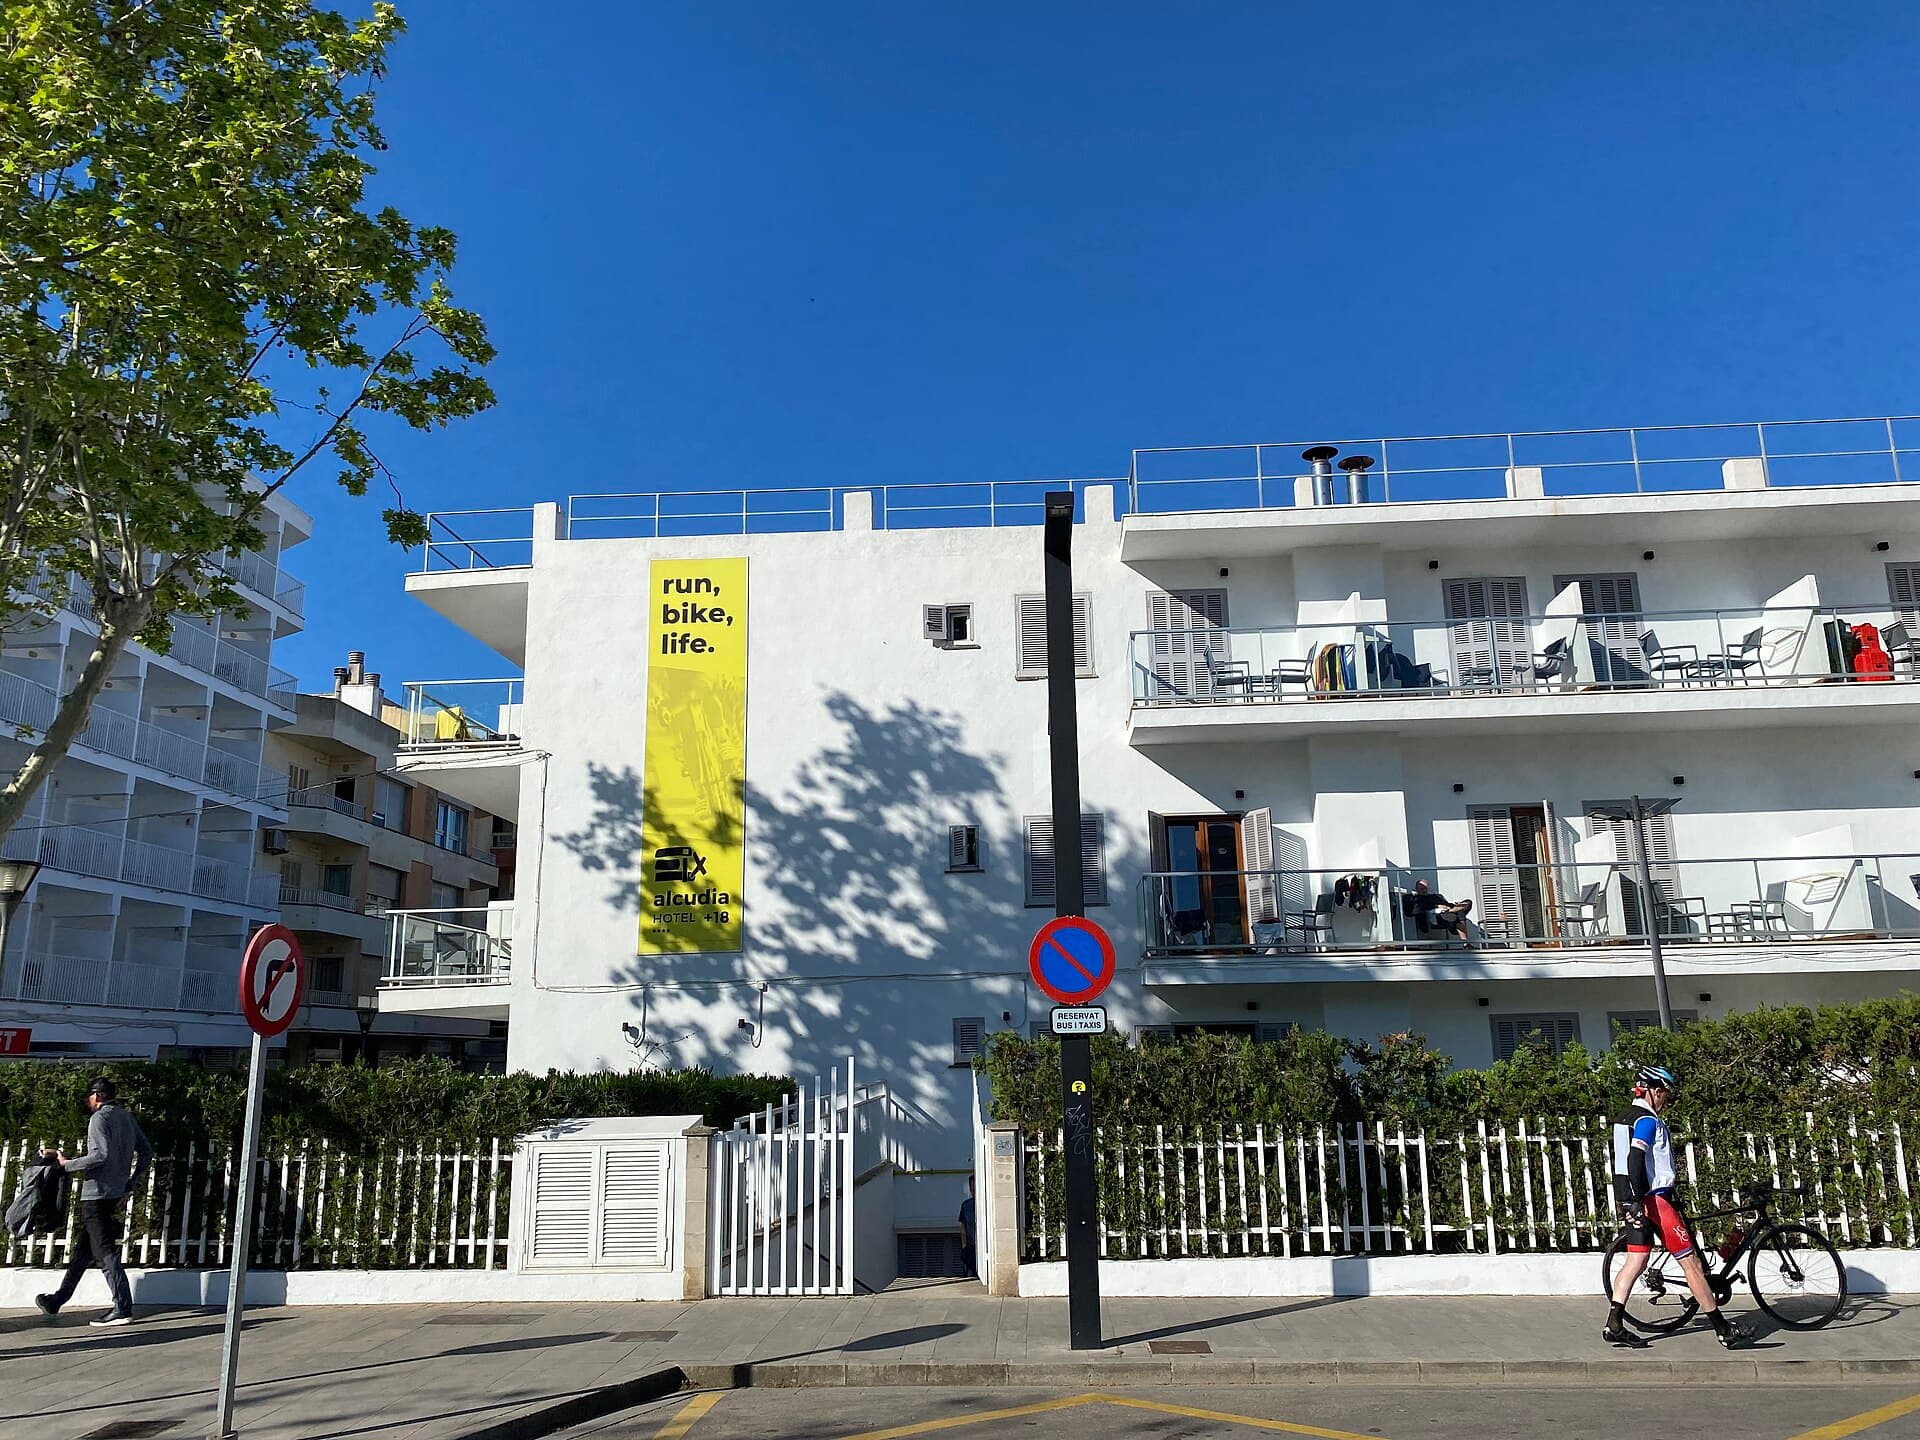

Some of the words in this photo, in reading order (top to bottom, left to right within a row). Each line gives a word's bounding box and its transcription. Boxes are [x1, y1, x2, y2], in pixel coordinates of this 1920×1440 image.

[663, 577, 720, 597] run,
[662, 602, 733, 626] bike,
[662, 632, 715, 655] life.
[653, 888, 729, 906] alcudia
[653, 912, 696, 924] HOTEL
[703, 911, 729, 924] +18
[1057, 1012, 1100, 1020] RESERVAT
[1078, 1021, 1102, 1029] TAXIS
